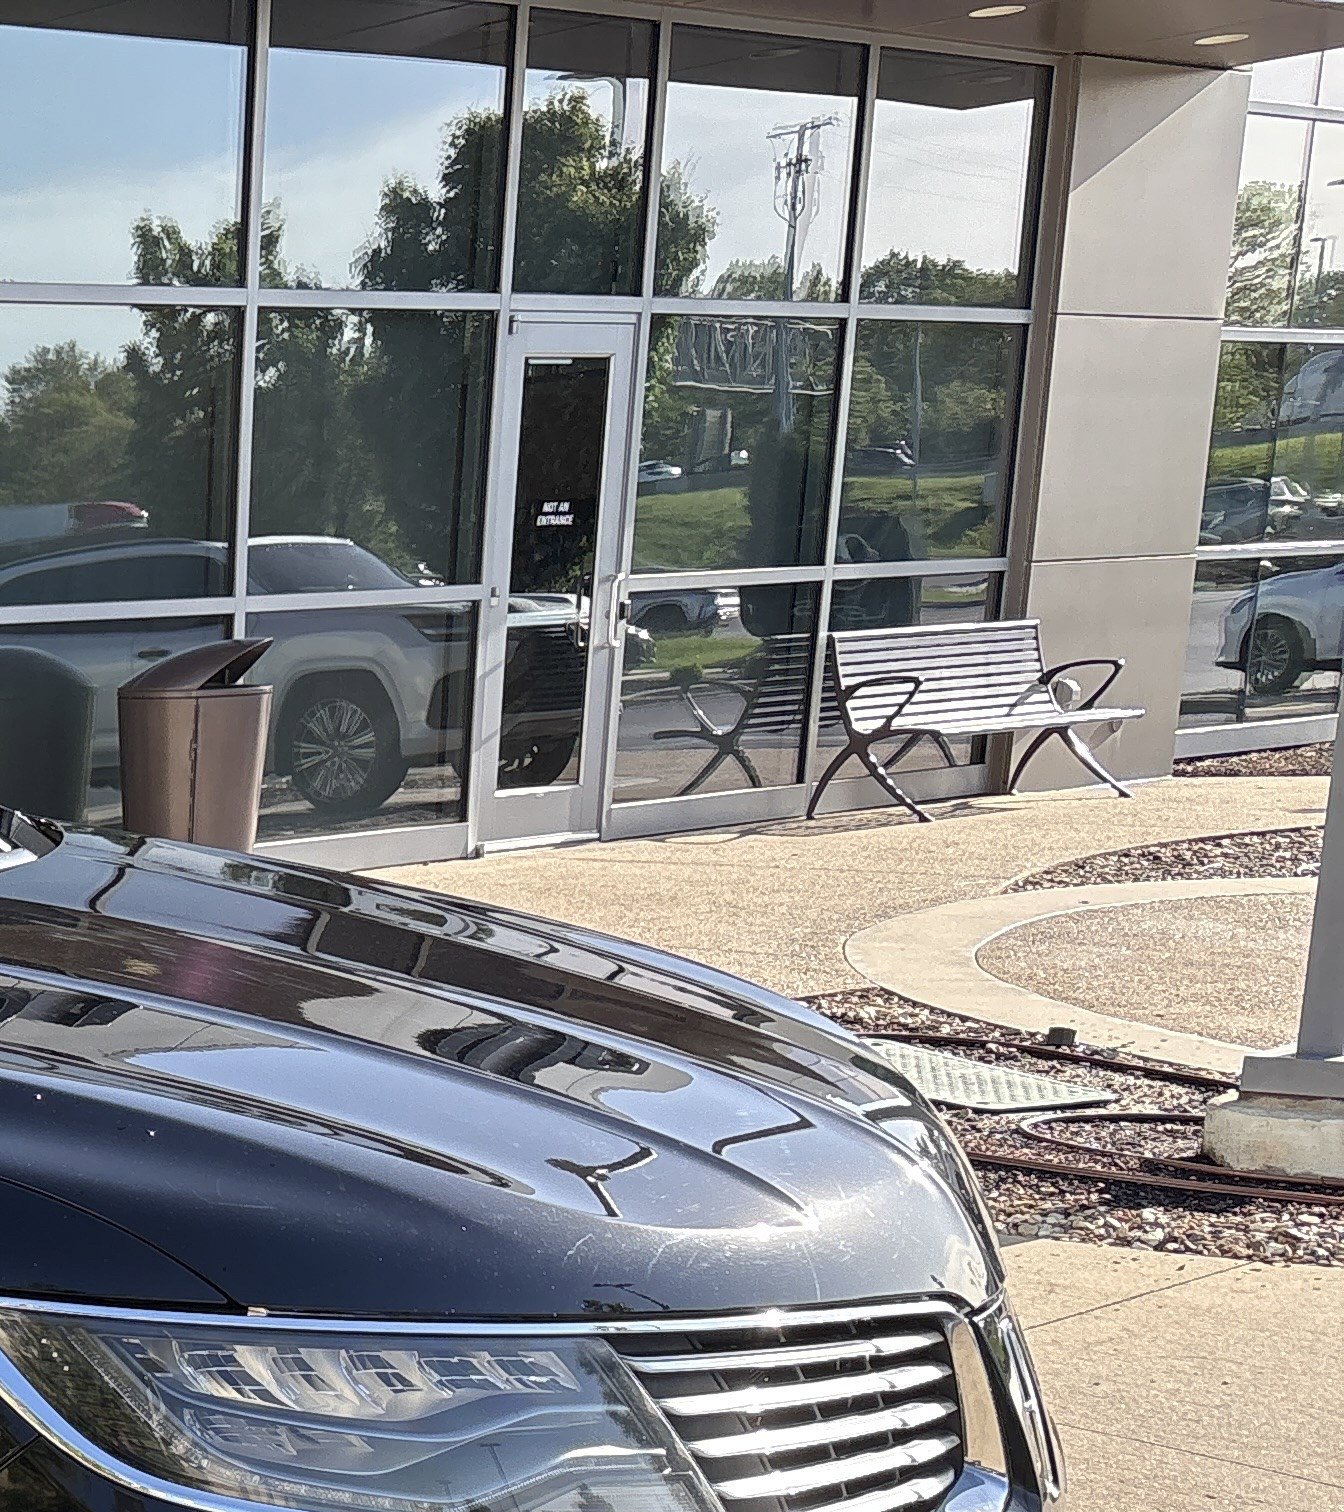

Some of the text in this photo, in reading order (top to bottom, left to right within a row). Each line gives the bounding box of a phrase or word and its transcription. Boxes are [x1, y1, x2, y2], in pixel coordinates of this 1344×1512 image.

[542, 501, 570, 512] NOT AN
[536, 514, 574, 526] ENTRANCE
